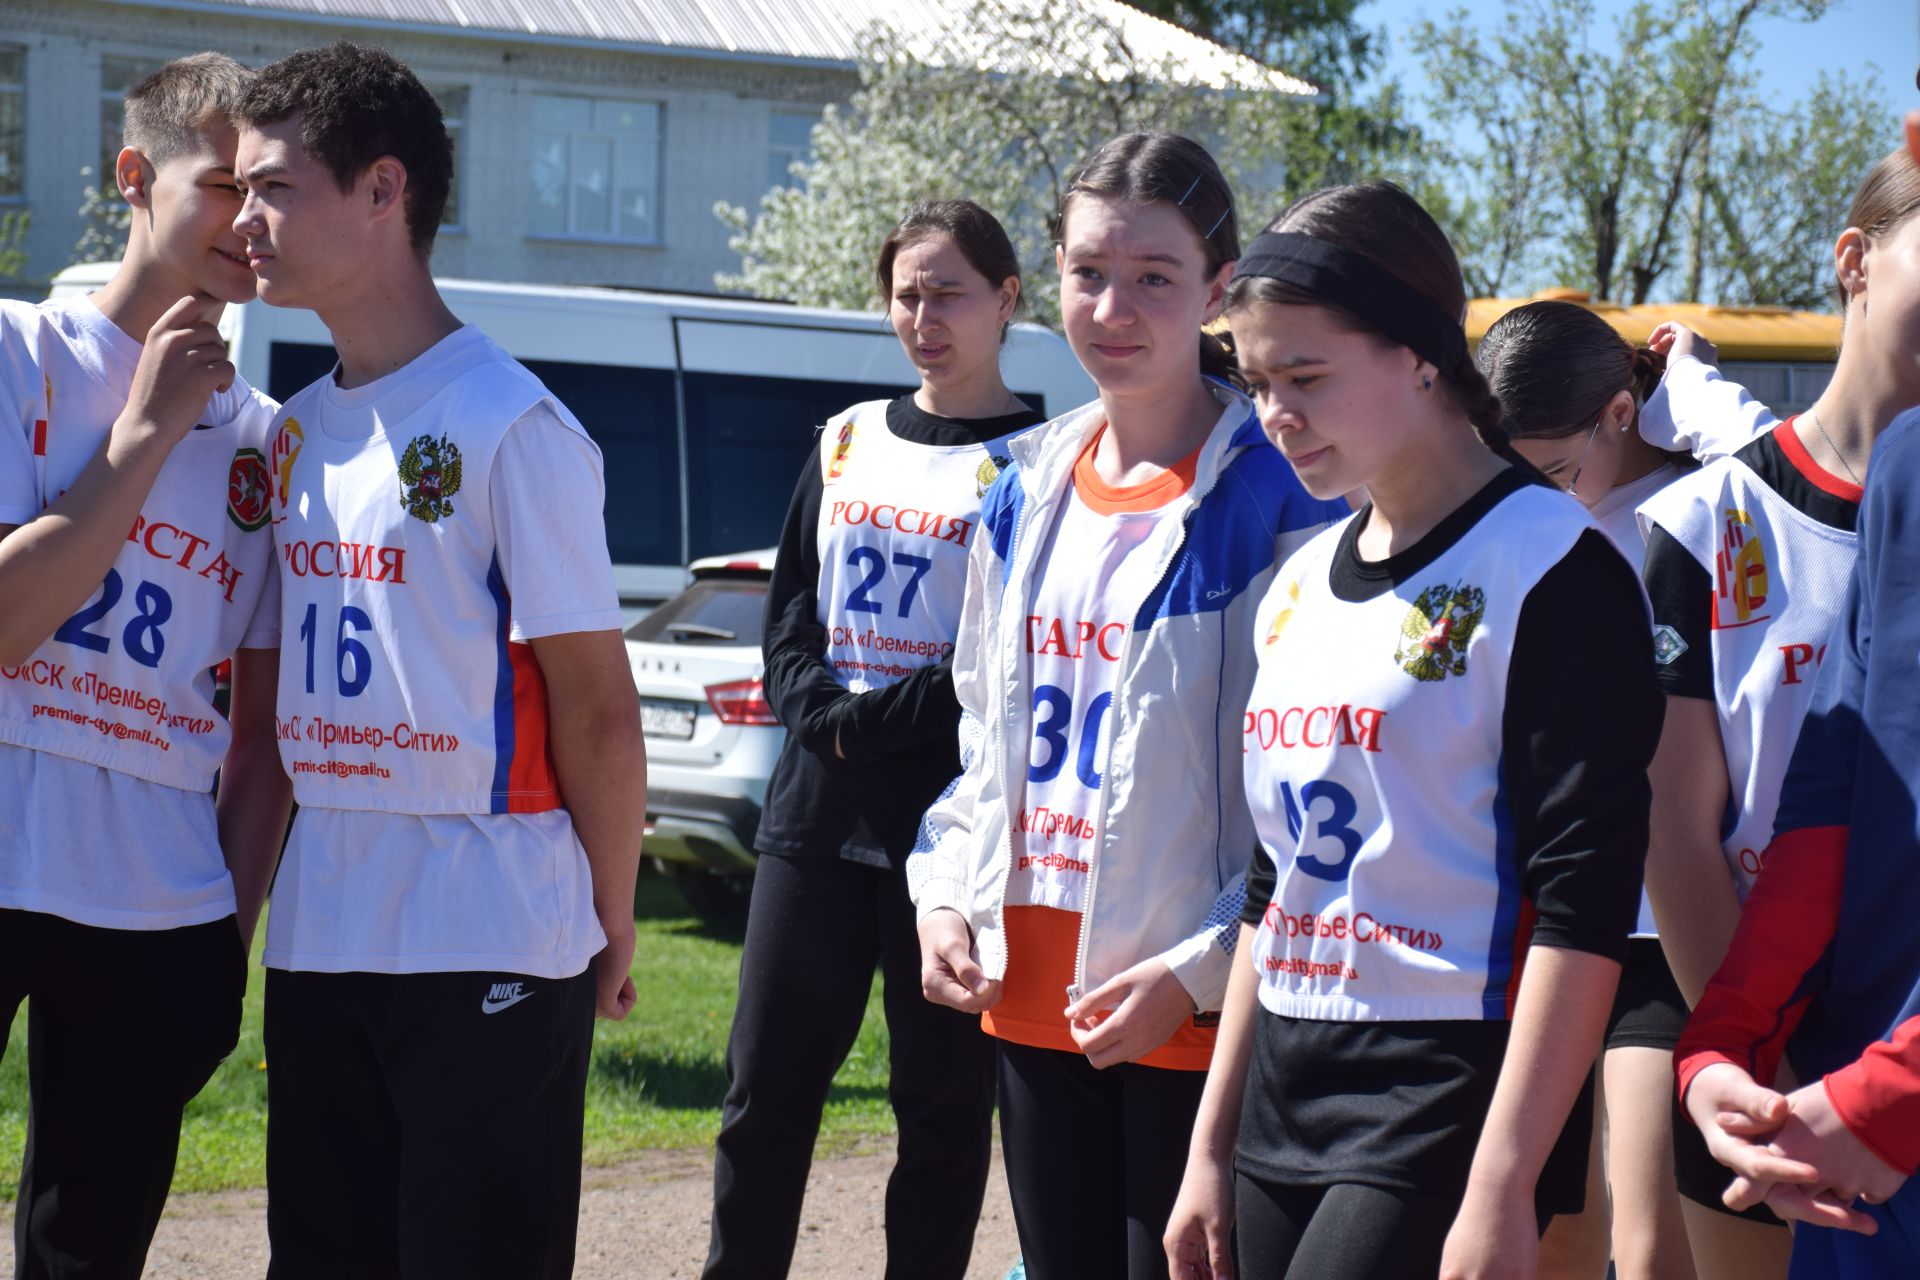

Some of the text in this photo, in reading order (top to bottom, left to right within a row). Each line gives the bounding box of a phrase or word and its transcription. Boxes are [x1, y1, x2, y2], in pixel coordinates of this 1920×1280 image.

[829, 500, 974, 548] РОССИЯ
[284, 540, 407, 585] РОССИЯ
[844, 545, 933, 619] 27
[53, 567, 173, 669] 28
[299, 603, 373, 698] 16
[1243, 704, 1388, 753] РОССИЯ
[488, 982, 524, 1000] NIKE
